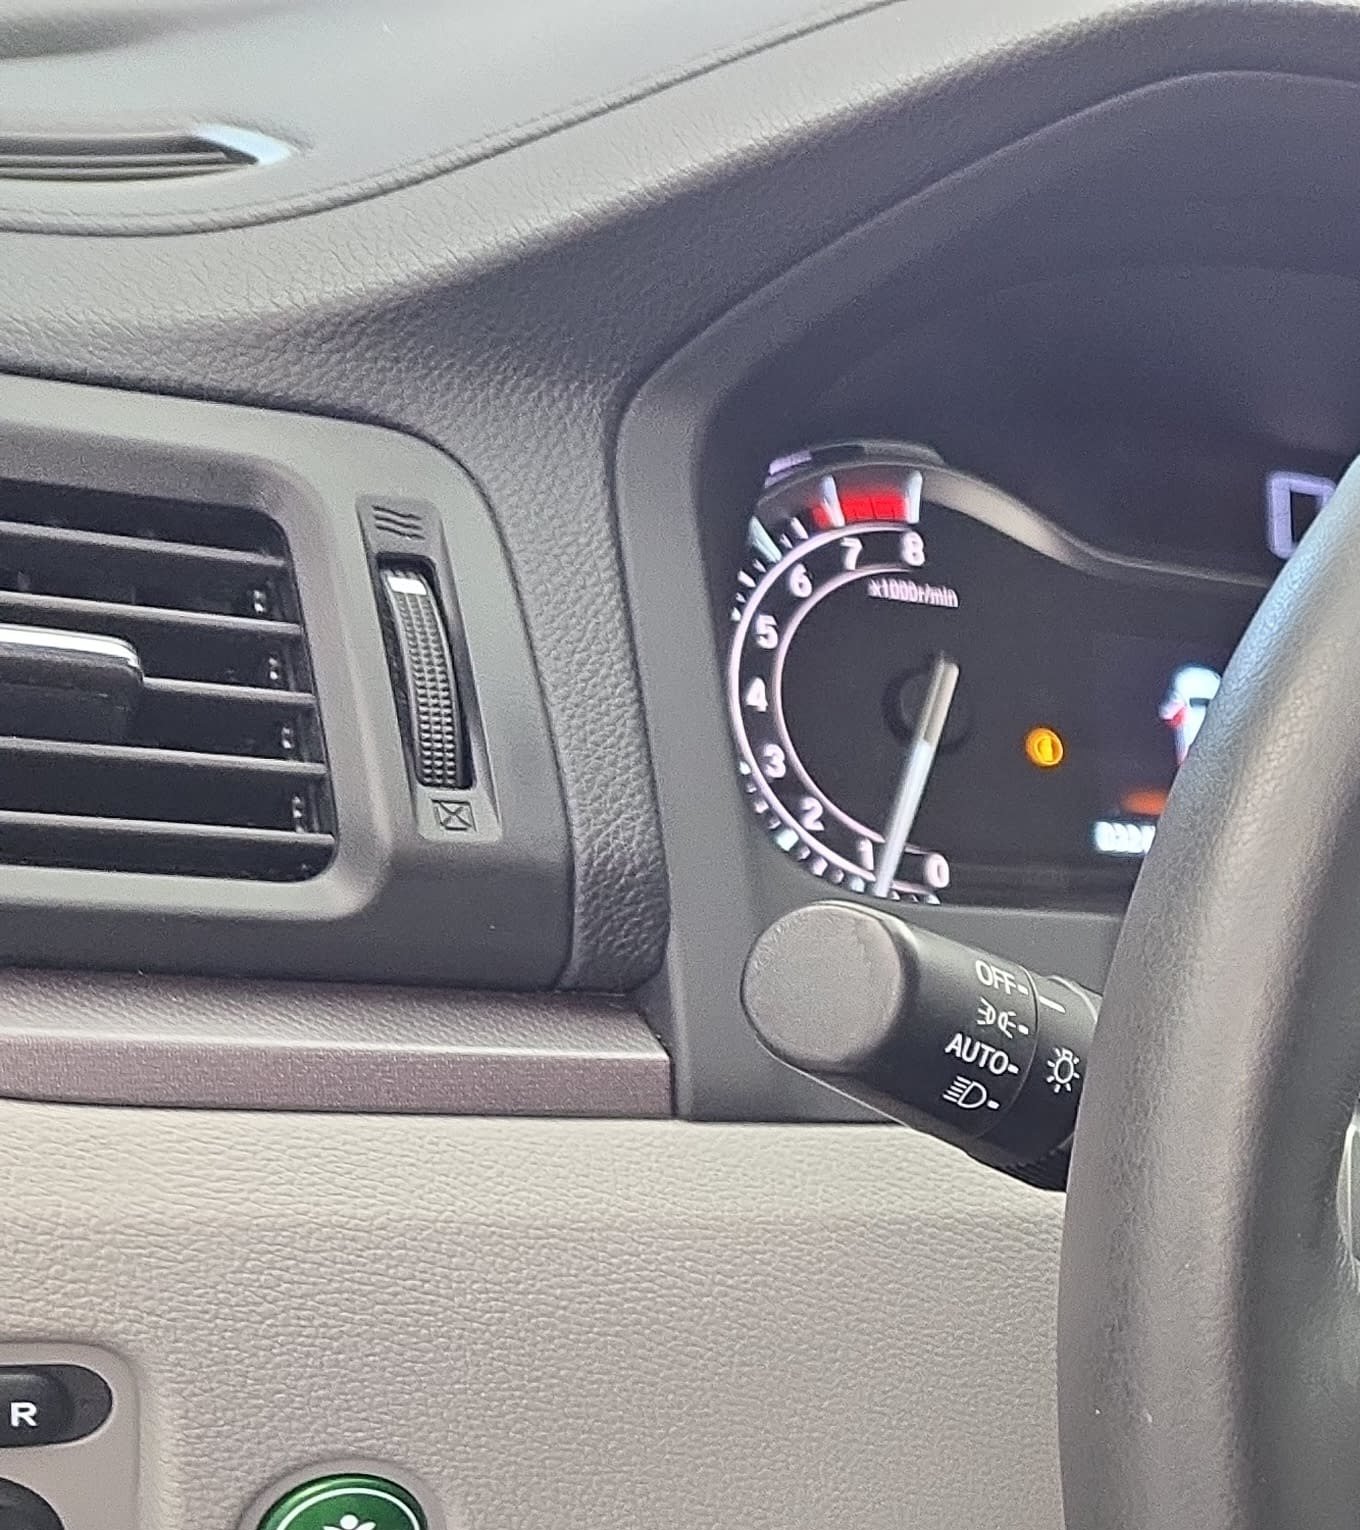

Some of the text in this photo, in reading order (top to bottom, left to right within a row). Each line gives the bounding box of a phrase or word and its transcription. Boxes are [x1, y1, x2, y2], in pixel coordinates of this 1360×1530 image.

[840, 537, 863, 571] 7
[900, 530, 925, 567] 8
[788, 563, 814, 598] 6
[754, 614, 779, 650] 5
[743, 676, 768, 713] 4
[761, 742, 787, 779] 3
[799, 795, 825, 832] 2
[924, 852, 951, 889] 0
[975, 959, 1016, 995] OFF
[944, 1033, 1010, 1077] AUTO
[10, 1401, 38, 1428] R
